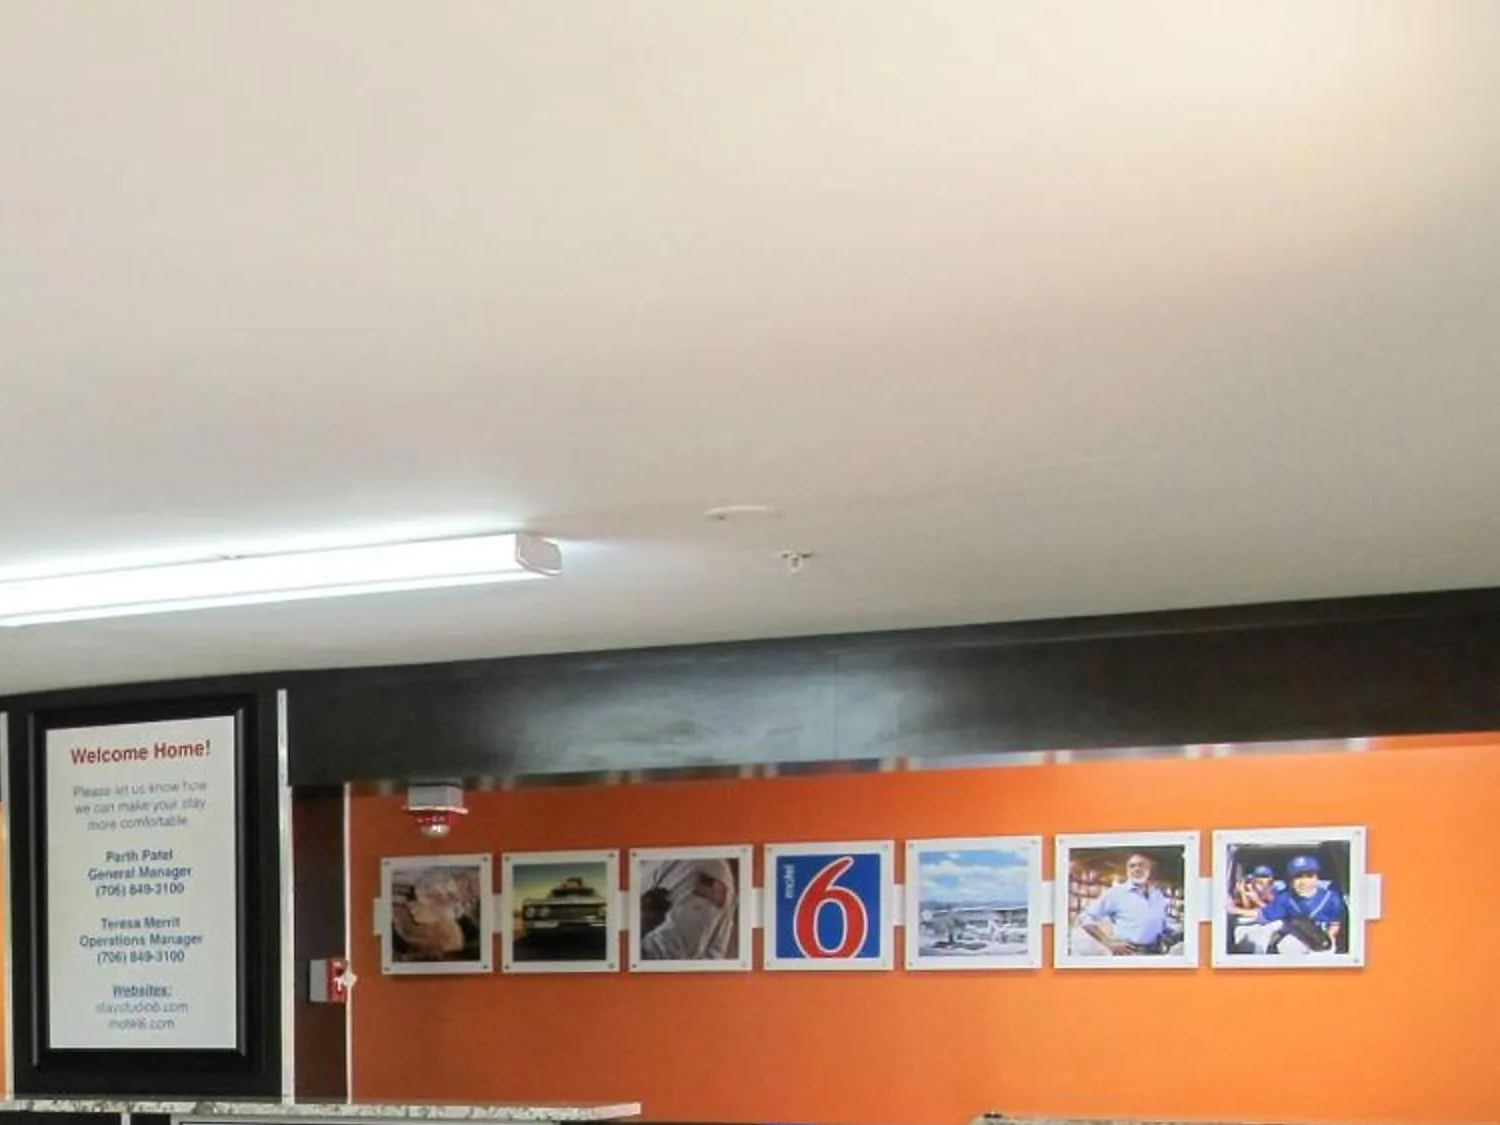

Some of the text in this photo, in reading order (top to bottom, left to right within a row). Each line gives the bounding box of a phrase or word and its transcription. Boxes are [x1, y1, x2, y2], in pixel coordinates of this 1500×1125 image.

[71, 739, 211, 765] Welcome Home!
[182, 780, 207, 793] how
[74, 804, 91, 815] we
[153, 799, 178, 814] your
[87, 820, 117, 831] more
[142, 848, 173, 861] Patel
[87, 866, 192, 881] General Manager
[793, 856, 868, 959] 6
[101, 917, 141, 929] Teresa
[79, 933, 203, 948] Operations Manager
